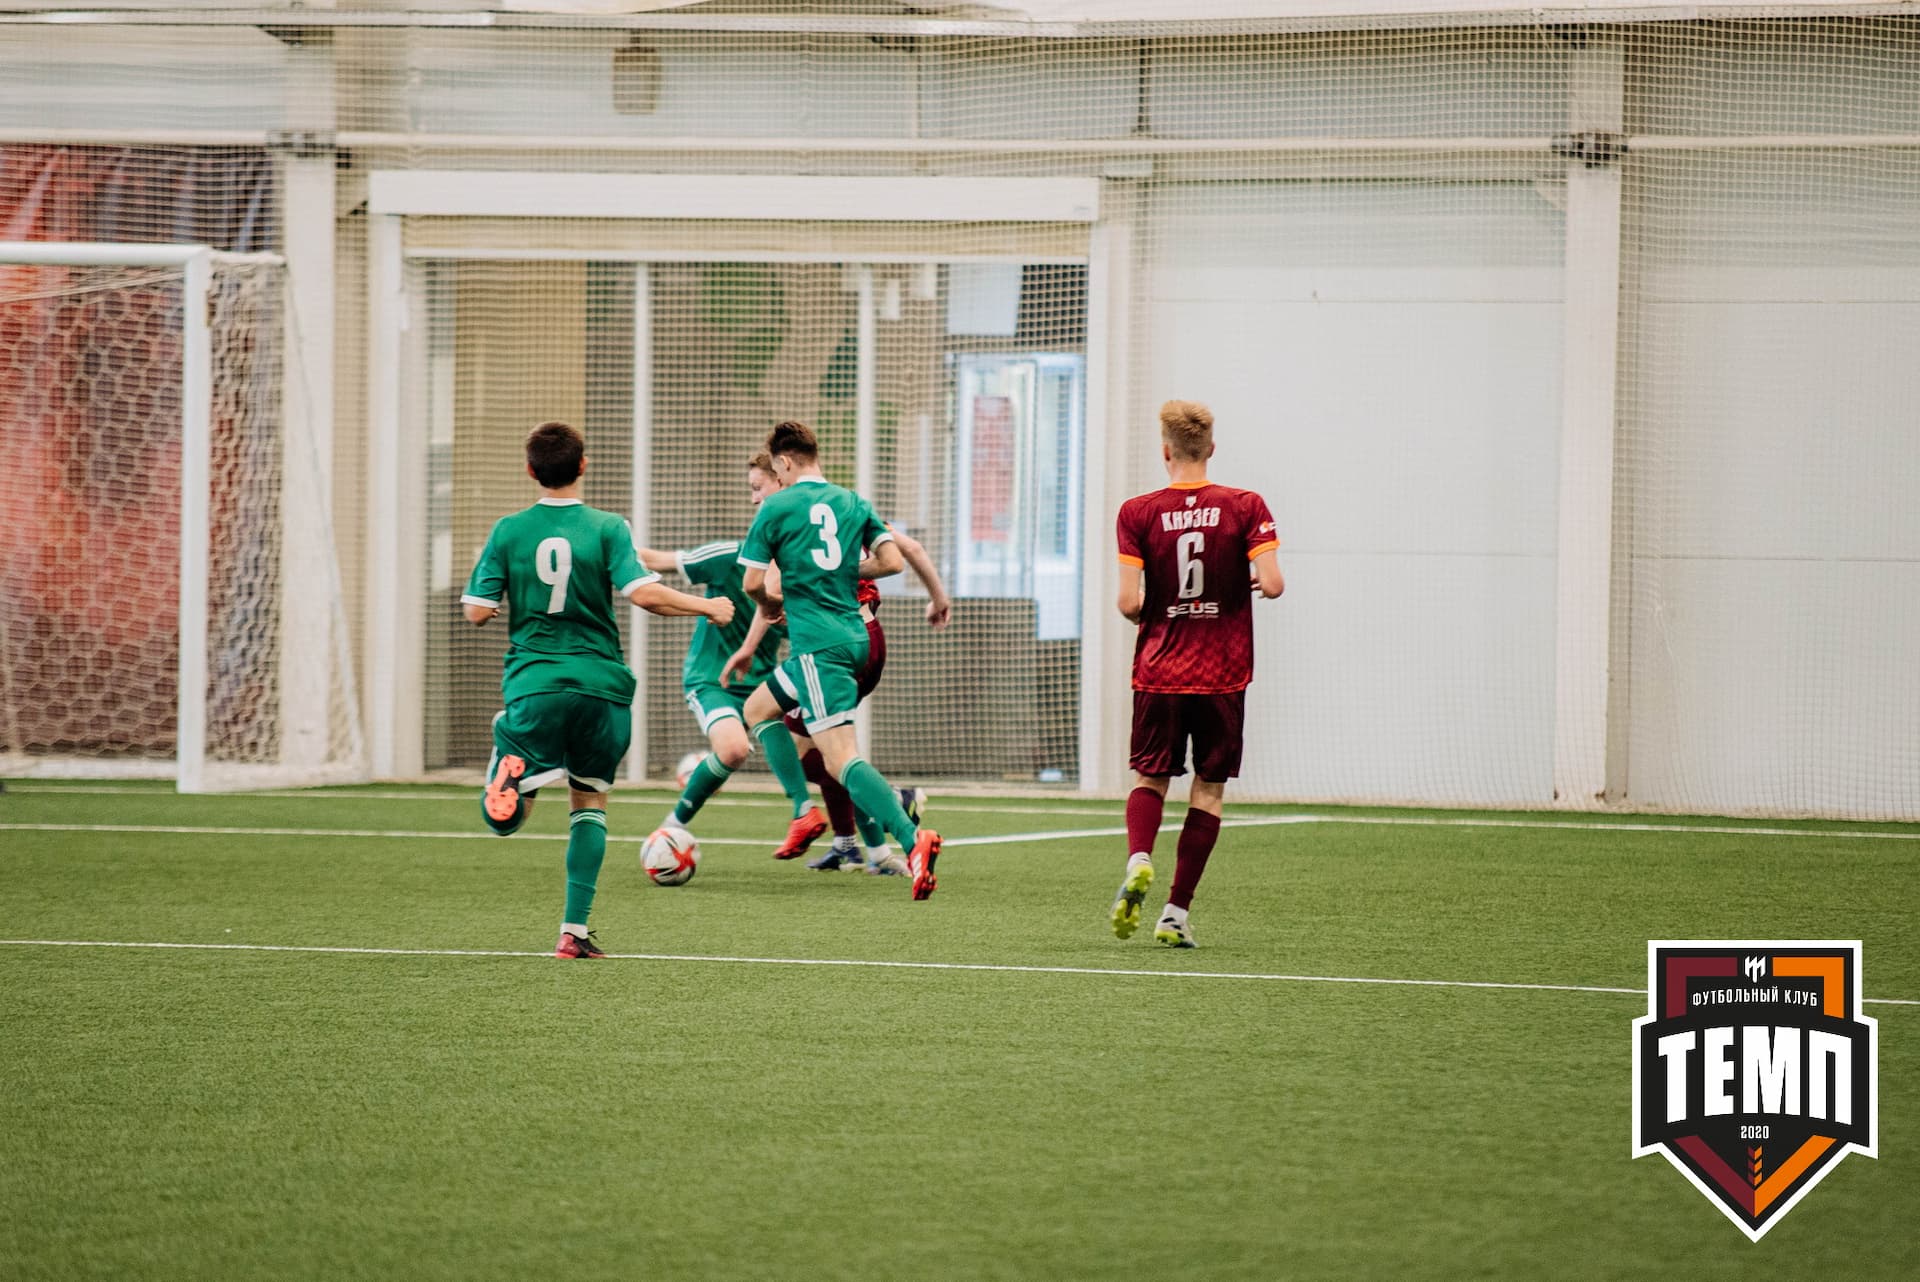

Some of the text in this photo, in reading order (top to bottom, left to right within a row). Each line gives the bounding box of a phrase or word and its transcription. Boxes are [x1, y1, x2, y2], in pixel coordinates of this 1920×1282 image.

[809, 503, 842, 571] 3
[1161, 507, 1221, 532] КНЯЗЕВ
[535, 537, 573, 614] 9
[1177, 531, 1205, 599] 6
